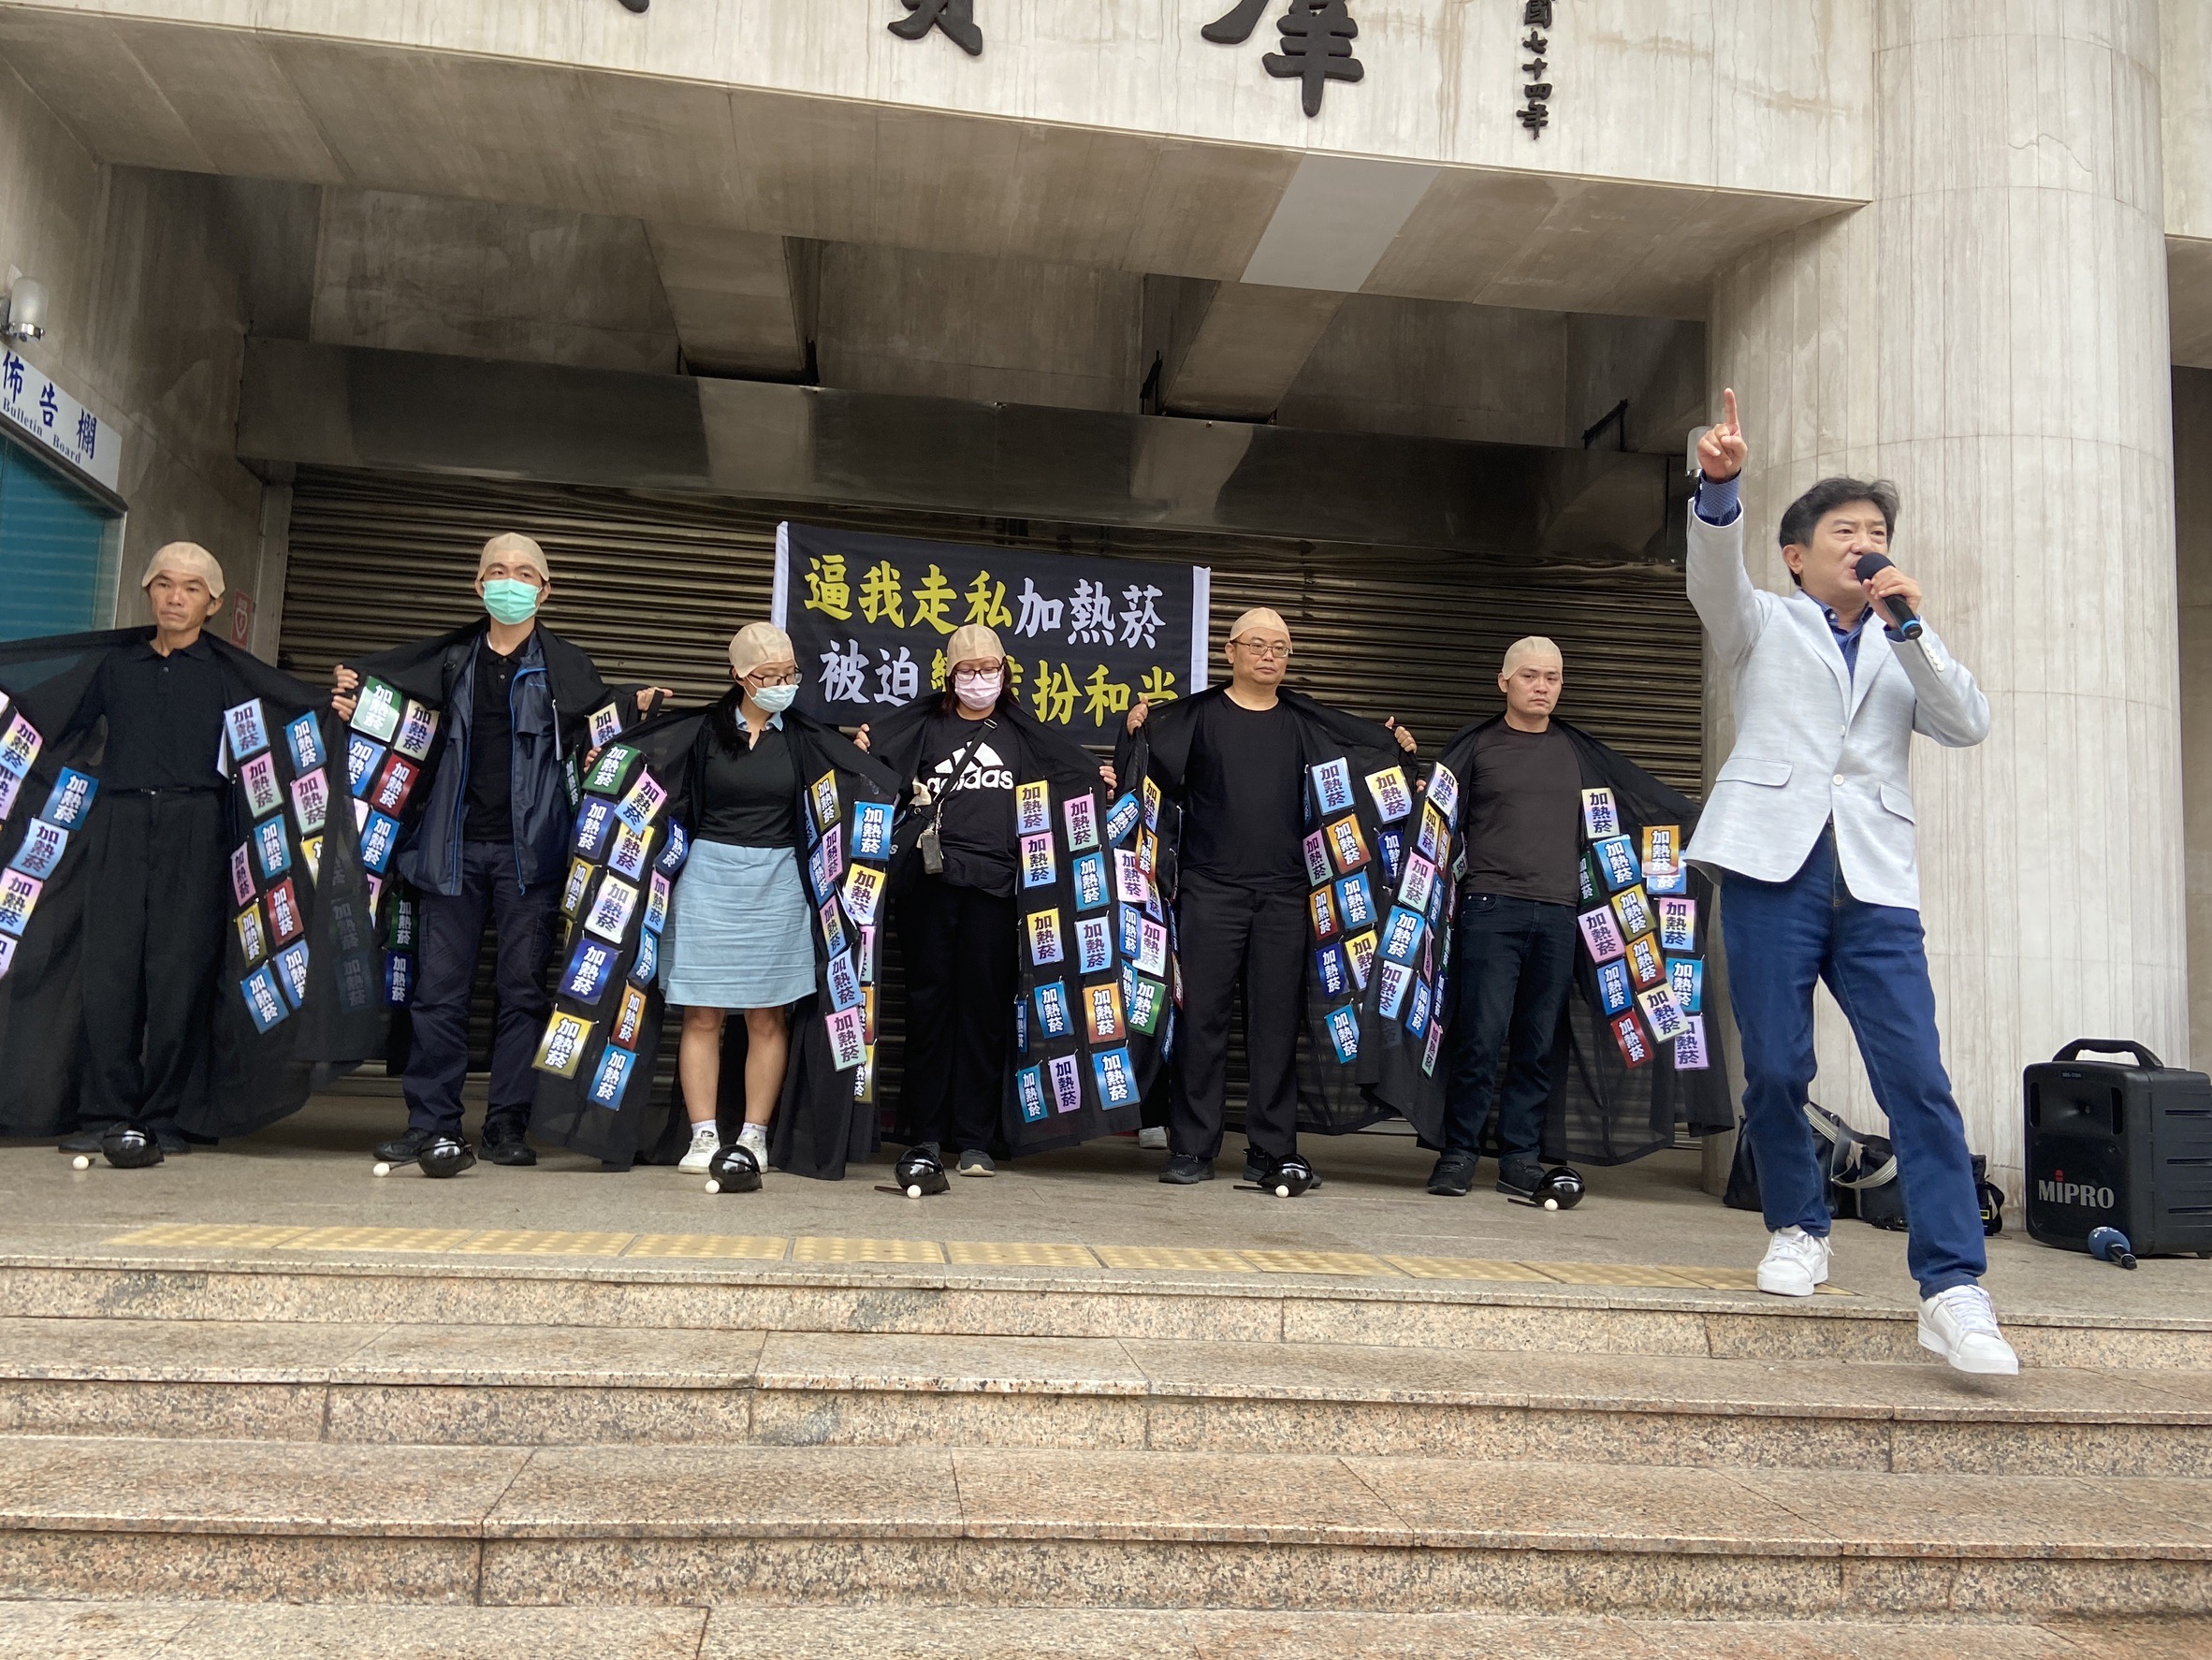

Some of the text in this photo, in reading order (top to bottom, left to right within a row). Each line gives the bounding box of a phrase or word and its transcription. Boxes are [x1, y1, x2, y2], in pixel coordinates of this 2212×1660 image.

[3, 349, 97, 460] 佈告欄
[3, 397, 81, 464] Bulletin Board
[803, 554, 1167, 649] 逼我走私加熱菸
[233, 706, 260, 751] 加熱菸
[363, 684, 394, 732] 加熱菸
[402, 706, 432, 753] 加熱菸
[1, 722, 36, 768] 加熱菸
[294, 721, 316, 768] 加熱菸
[594, 747, 628, 787] 加熱菸
[53, 775, 89, 823] 加熱菸
[249, 761, 273, 808] 加熱菸
[298, 776, 326, 825] 加熱菸
[379, 762, 411, 809] 加熱菸
[623, 780, 660, 825] 加熱菸
[818, 779, 835, 824] 加熱菸
[1320, 764, 1346, 807] 加熱菸
[1375, 774, 1406, 815] 加熱菸
[1433, 769, 1455, 807] 加熱菸
[577, 803, 607, 851] 加熱菸
[1022, 787, 1042, 828] 加熱菸
[1070, 801, 1091, 845] 加熱菸
[1590, 793, 1612, 833] 加熱菸
[21, 825, 60, 872] 加熱菸
[262, 823, 283, 871] 加熱菸
[363, 818, 392, 866] 加熱菸
[861, 807, 883, 854] 加熱菸
[1334, 822, 1360, 866] 加熱菸
[1422, 809, 1436, 852] 加熱菸
[1652, 830, 1671, 871] 加熱菸
[235, 851, 250, 898] 加熱菸
[826, 831, 837, 877] 加熱菸
[1028, 838, 1049, 881] 加熱菸
[1122, 853, 1142, 896] 加熱菸
[1306, 837, 1326, 880] 加熱菸
[1606, 841, 1633, 884] 加熱菸
[565, 866, 587, 911] 加熱菸
[1080, 859, 1099, 903] 加熱菸
[1404, 860, 1428, 904] 加熱菸
[1579, 858, 1594, 899] 加熱菸
[0, 876, 33, 927] 加熱菸
[272, 887, 294, 937] 加熱菸
[397, 899, 412, 945] 加熱菸
[595, 883, 630, 931] 加熱菸
[648, 878, 665, 925] 加熱菸
[1316, 893, 1331, 935] 加熱菸
[1345, 880, 1366, 923] 加熱菸
[1620, 891, 1647, 934] 加熱菸
[1665, 902, 1687, 946] 加熱菸
[242, 912, 260, 960] 加熱菸
[824, 904, 841, 952] 加熱菸
[1035, 915, 1055, 959] 加熱菸
[1084, 923, 1105, 968] 加熱菸
[1125, 908, 1137, 953] 加熱菸
[1143, 925, 1160, 968] 加熱菸
[1388, 913, 1417, 958] 加熱菸
[1586, 912, 1616, 956] 加熱菸
[392, 955, 407, 1002] 加熱菸
[571, 945, 606, 996] 加熱菸
[636, 934, 654, 980] 加熱菸
[1323, 950, 1341, 993] 加熱菸
[1633, 940, 1656, 983] 加熱菸
[249, 974, 278, 1024] 加熱菸
[832, 956, 855, 1005] 加熱菸
[1604, 966, 1624, 1009] 加熱菸
[1673, 962, 1693, 1007] 加熱菸
[618, 995, 641, 1043] 加熱菸
[1041, 988, 1063, 1032] 加熱菸
[1094, 990, 1114, 1036] 加熱菸
[1130, 982, 1156, 1027] 加熱菸
[1647, 990, 1680, 1035] 加熱菸
[545, 1018, 581, 1069] 加熱菸
[835, 1013, 860, 1063] 加熱菸
[1333, 1012, 1358, 1056] 加熱菸
[1618, 1017, 1645, 1062] 加熱菸
[596, 1050, 626, 1100] 加熱菸
[1023, 1072, 1041, 1116] 加熱菸
[1055, 1061, 1076, 1107] 加熱菸
[1102, 1054, 1128, 1101] 加熱菸
